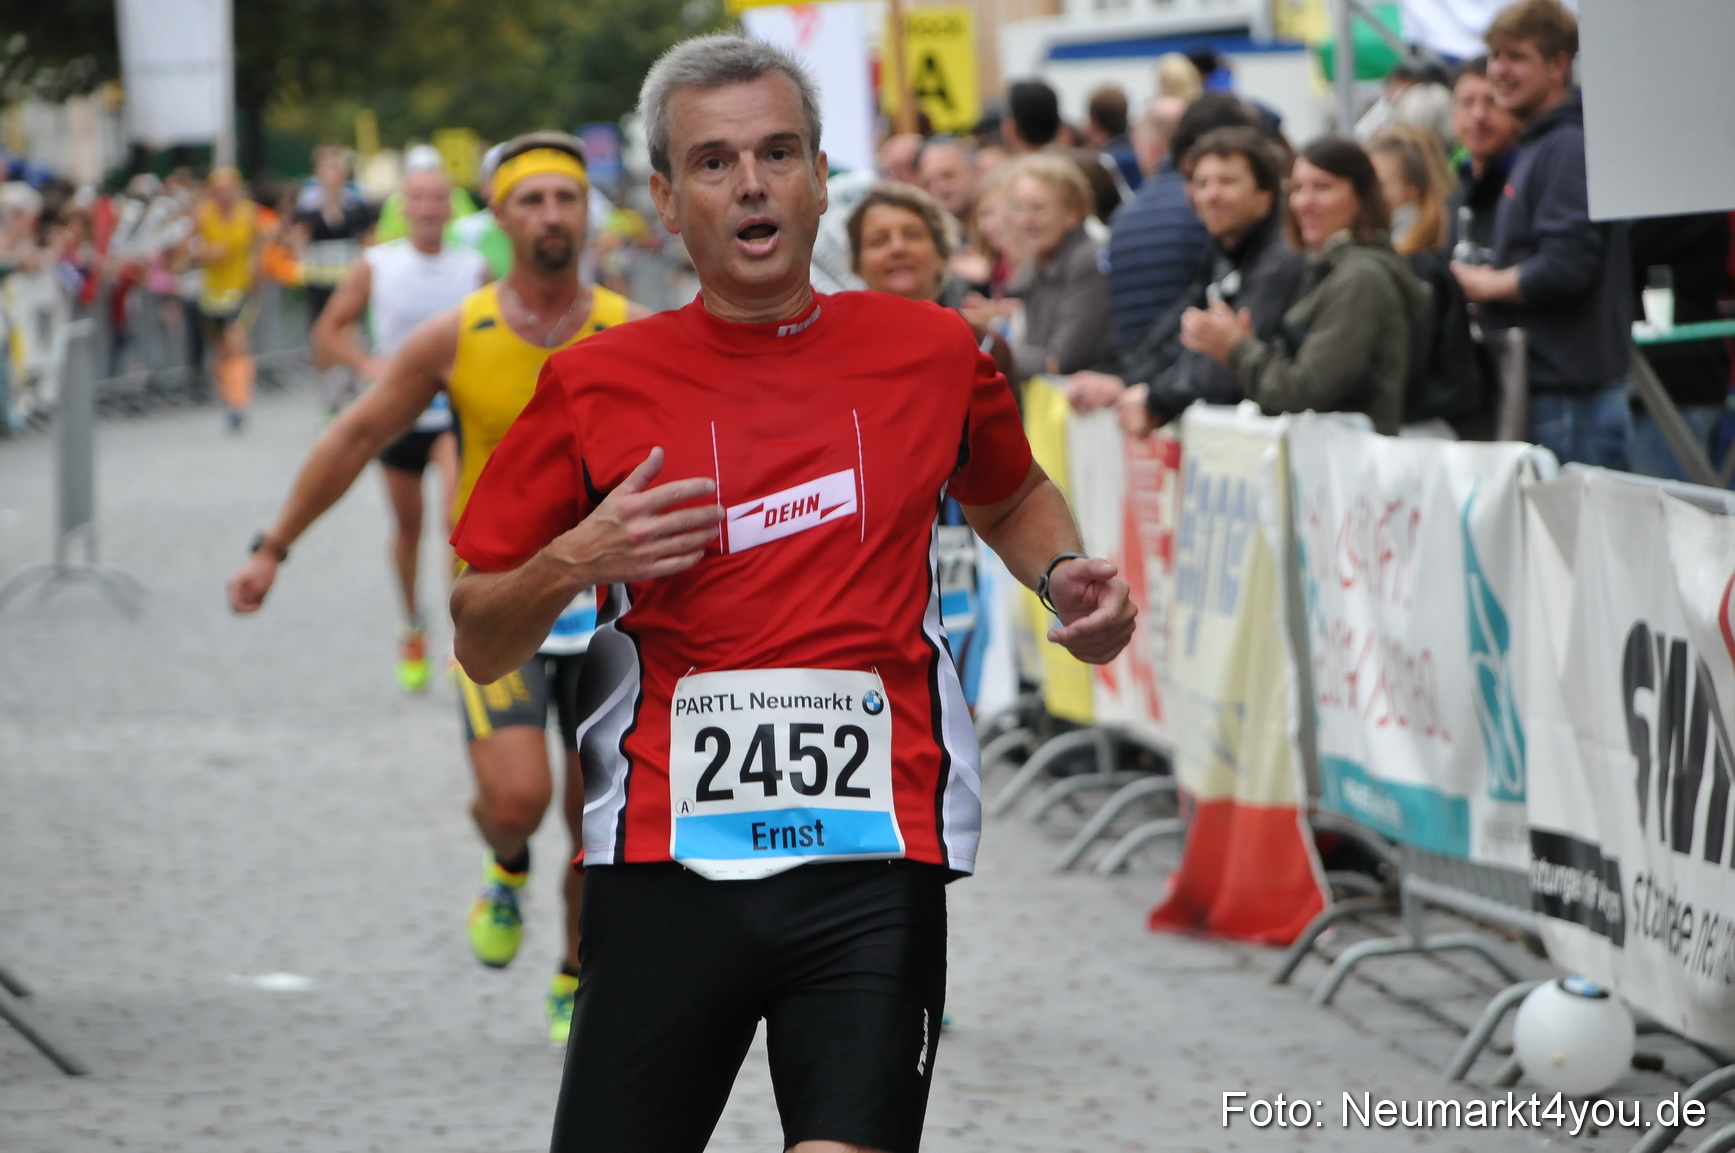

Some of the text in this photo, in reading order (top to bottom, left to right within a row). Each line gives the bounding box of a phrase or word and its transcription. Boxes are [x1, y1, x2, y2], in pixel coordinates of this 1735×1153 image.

[914, 51, 956, 110] A
[764, 492, 820, 528] DEHN
[675, 691, 853, 716] PARTL Neumarkt
[694, 723, 871, 802] 2452
[681, 801, 689, 814] A
[751, 819, 824, 851] Ernst
